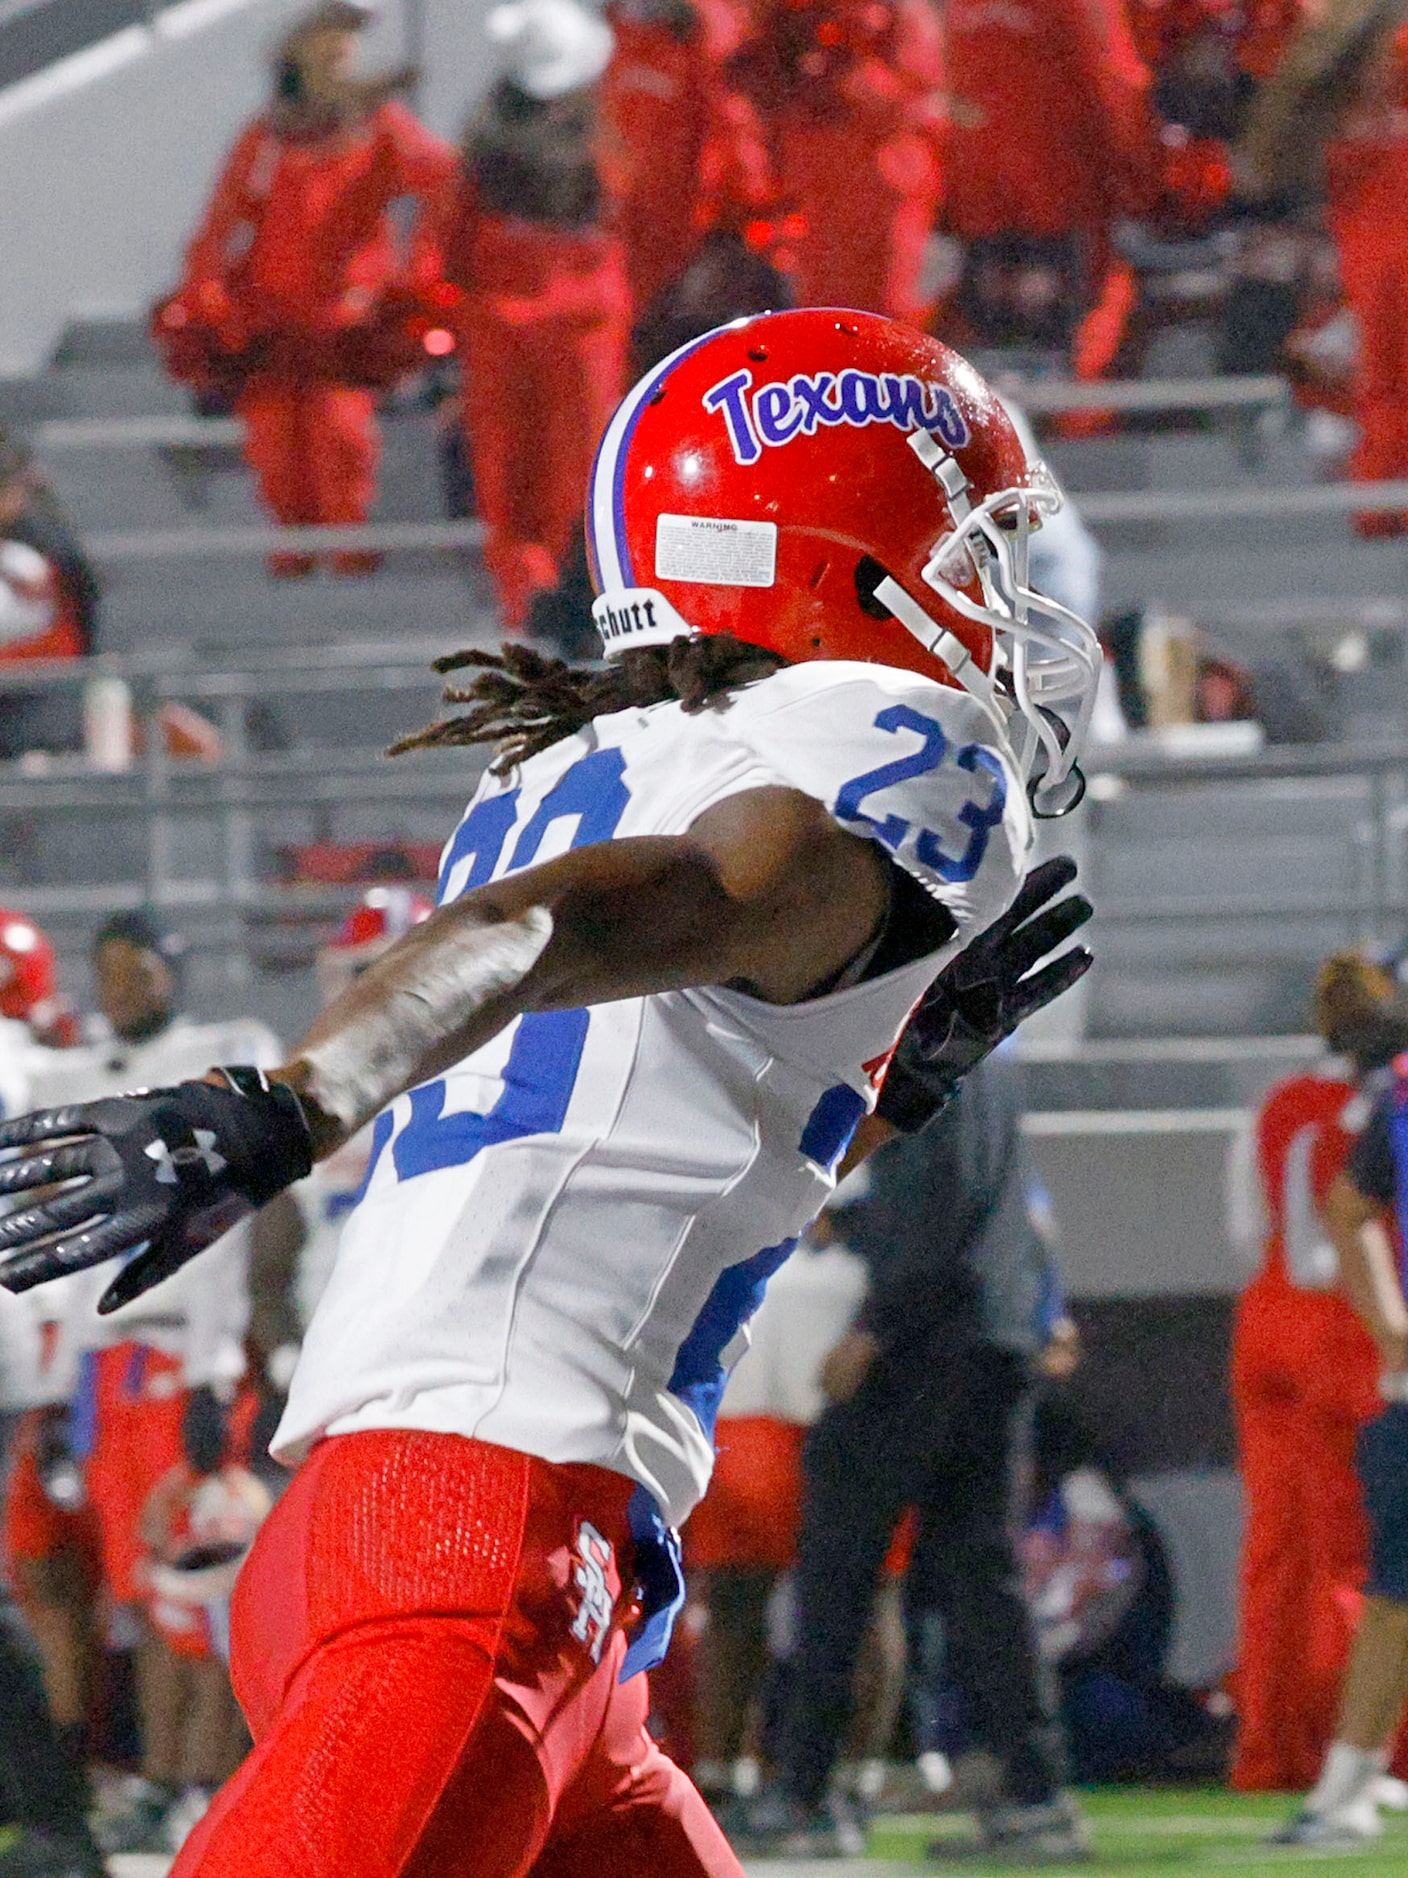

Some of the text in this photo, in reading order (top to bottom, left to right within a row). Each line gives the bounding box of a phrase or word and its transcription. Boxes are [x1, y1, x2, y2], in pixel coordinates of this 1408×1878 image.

[702, 367, 971, 465] Texans
[692, 520, 738, 531] WARNING
[834, 704, 1007, 883] 23
